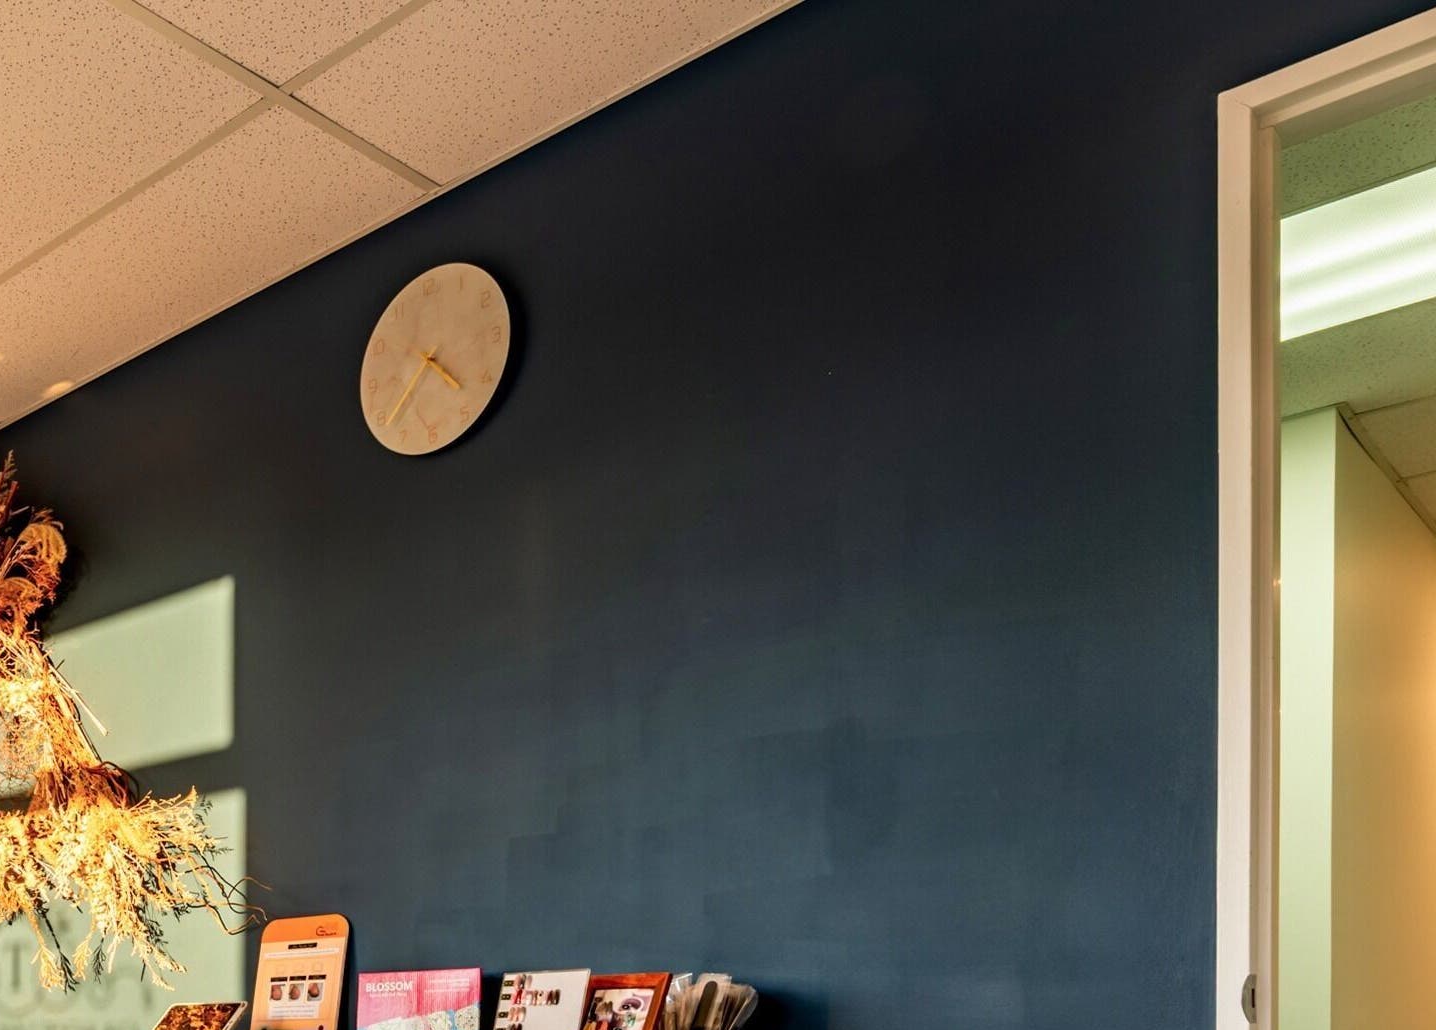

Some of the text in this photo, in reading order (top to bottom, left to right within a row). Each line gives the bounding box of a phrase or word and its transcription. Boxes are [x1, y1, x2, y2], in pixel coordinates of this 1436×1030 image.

[480, 288, 491, 310] 2
[491, 325, 501, 344] 3
[368, 378, 378, 393] 9
[481, 369, 492, 384] 4
[377, 410, 386, 427] 8
[460, 404, 471, 425] 5
[427, 424, 438, 444] 6
[365, 981, 413, 993] BLOSSOM
